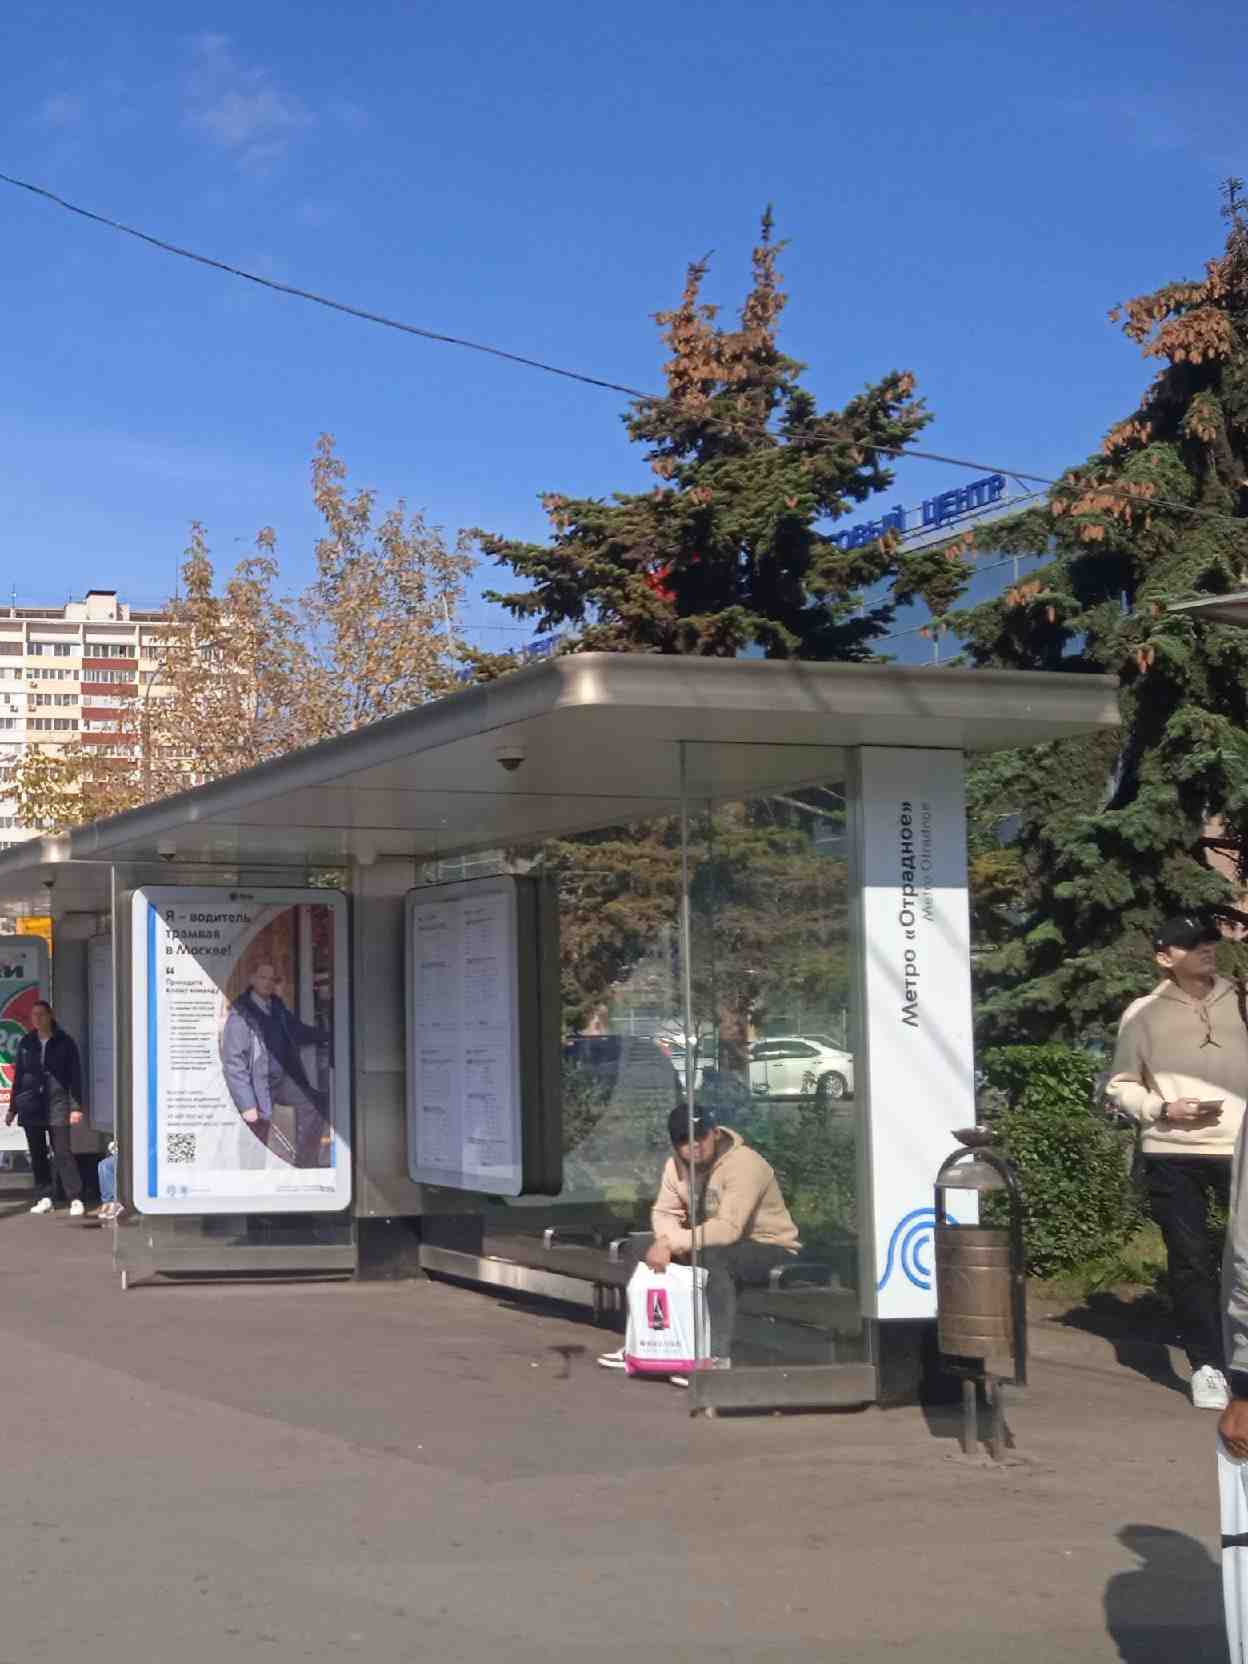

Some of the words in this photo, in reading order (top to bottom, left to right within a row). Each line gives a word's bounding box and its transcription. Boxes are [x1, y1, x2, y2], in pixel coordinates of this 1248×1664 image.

[898, 801, 919, 940] «Отрадное»
[166, 910, 174, 921] Я
[190, 912, 251, 923] водитель
[166, 929, 220, 940] трамвая
[166, 946, 173, 954] в
[176, 944, 232, 956] Москве!
[901, 949, 920, 1028] Метро
